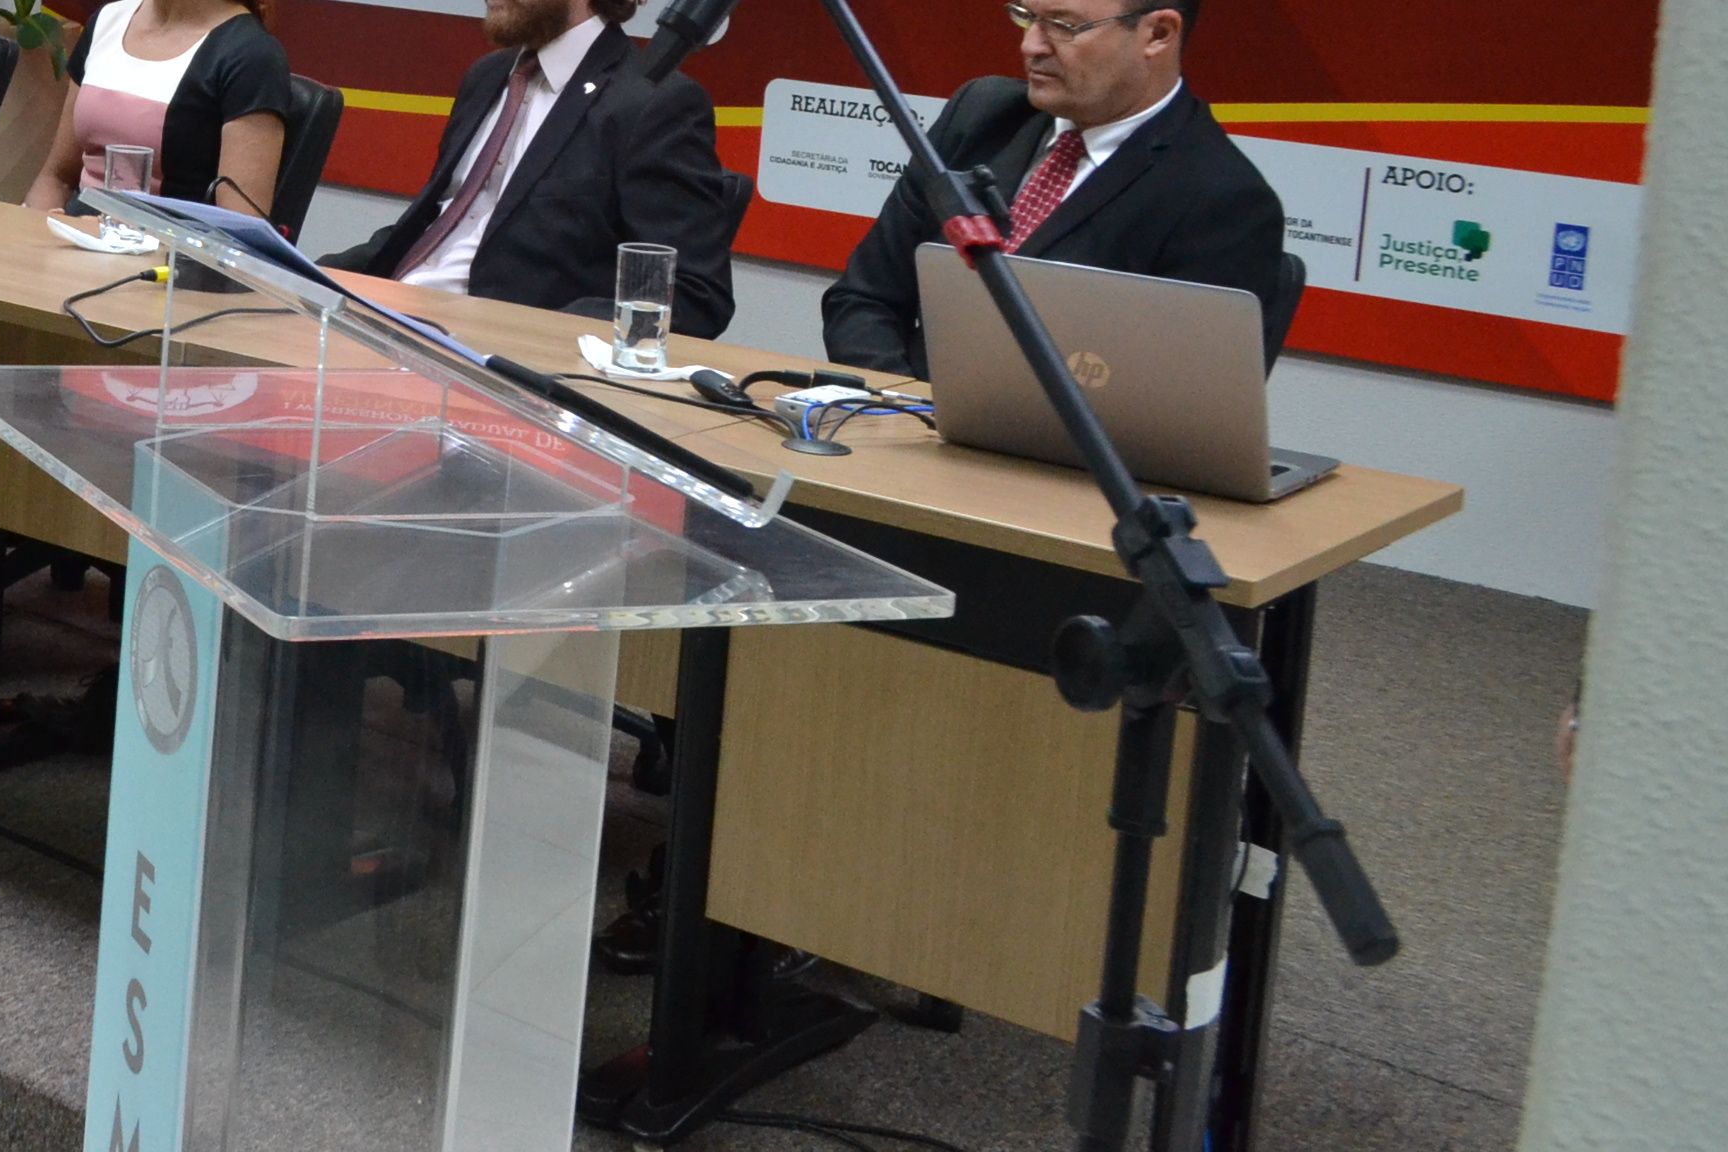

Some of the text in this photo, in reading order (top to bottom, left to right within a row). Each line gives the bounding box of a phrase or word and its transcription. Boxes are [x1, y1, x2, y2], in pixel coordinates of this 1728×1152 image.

[790, 94, 925, 128] REALIZAÇ:
[769, 155, 809, 168] CIDADANIA
[816, 163, 848, 174] JUSTIÇA
[1382, 166, 1474, 195] APOIO:
[1287, 229, 1353, 247] TOCANTINENSE
[1379, 253, 1480, 282] Presente
